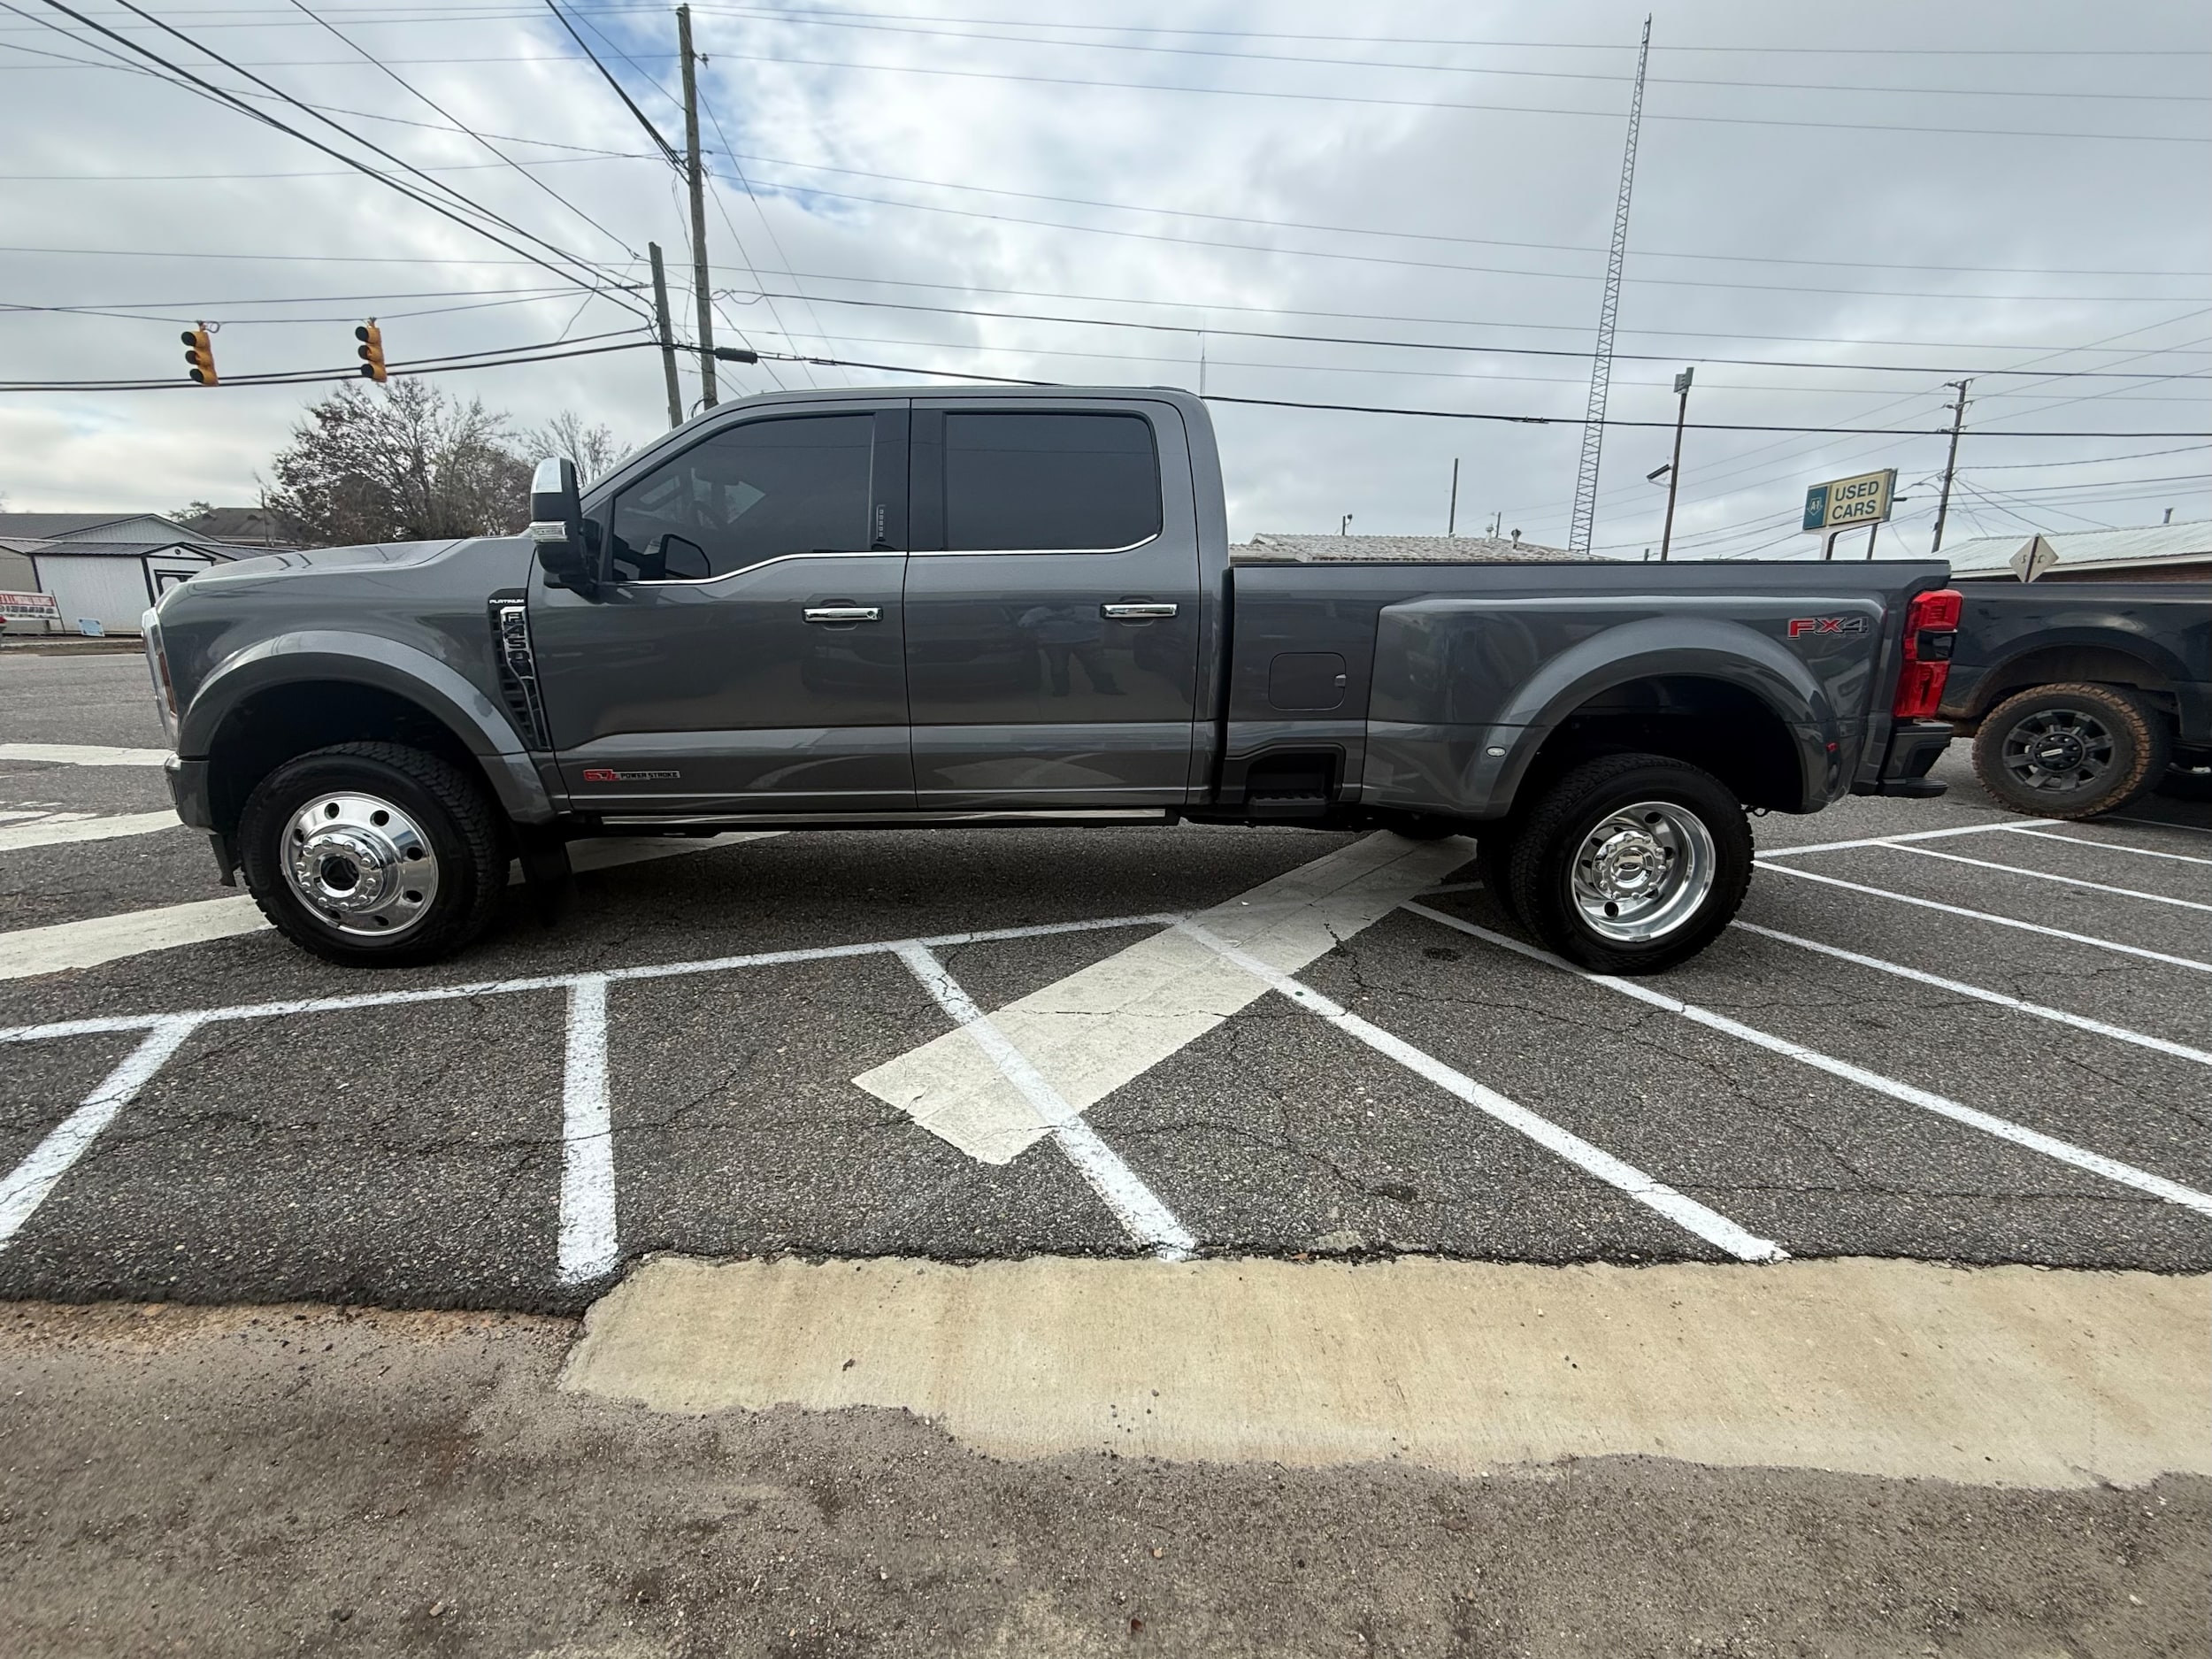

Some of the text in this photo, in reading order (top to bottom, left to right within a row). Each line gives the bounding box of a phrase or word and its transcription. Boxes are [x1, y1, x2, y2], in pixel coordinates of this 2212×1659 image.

[1834, 480, 1879, 502] USED
[1832, 500, 1877, 520] CARS
[1787, 617, 1870, 640] FX4
